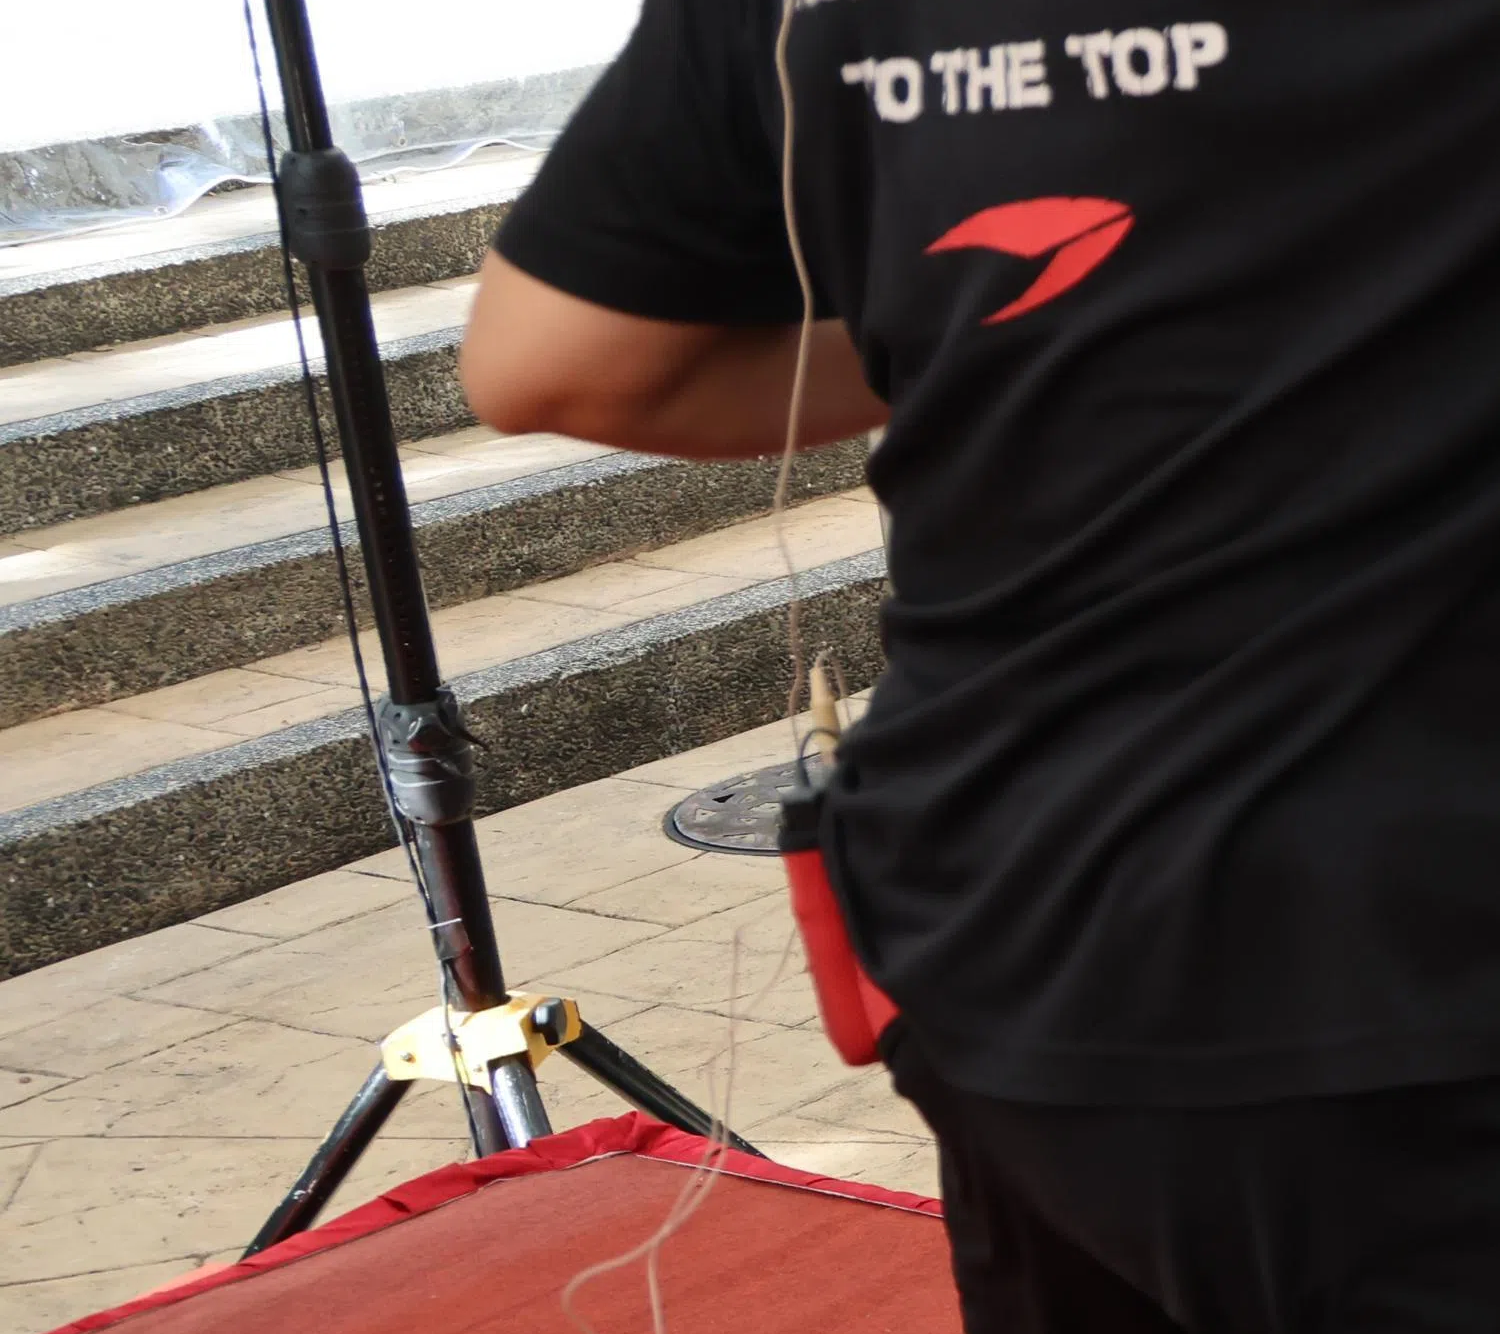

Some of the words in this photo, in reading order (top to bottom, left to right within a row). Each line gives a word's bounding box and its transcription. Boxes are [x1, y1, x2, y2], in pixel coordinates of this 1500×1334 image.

[842, 58, 922, 123] TO
[930, 41, 1052, 114] THE
[1066, 22, 1227, 99] TOP
